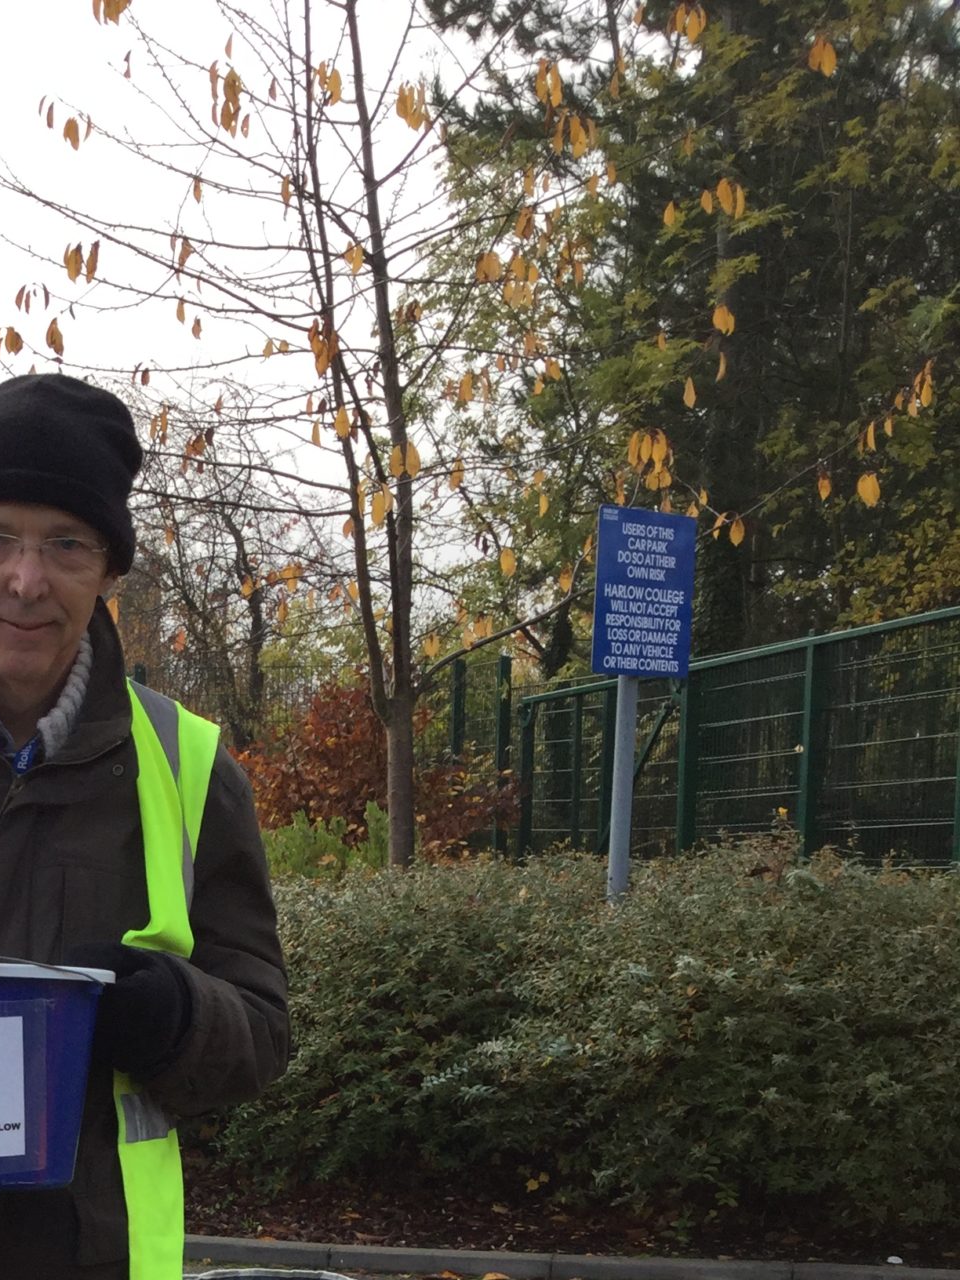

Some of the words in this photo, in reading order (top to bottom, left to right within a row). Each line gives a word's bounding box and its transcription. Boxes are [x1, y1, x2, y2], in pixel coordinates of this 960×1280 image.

[622, 522, 646, 537] USERS
[646, 525, 658, 538] OF
[658, 526, 675, 541] THIS
[628, 537, 646, 552] CAR
[646, 539, 668, 554] PARK
[617, 550, 631, 563] DO
[632, 552, 644, 565] SO
[644, 554, 655, 567] AT
[656, 554, 676, 569] THEIR
[627, 566, 649, 580] OWN
[649, 568, 666, 582] RISK
[604, 583, 644, 600] HARLOW
[645, 588, 684, 605] COLLEGE
[610, 599, 628, 613] WILL
[629, 600, 646, 615] NOT
[647, 603, 678, 618] ACCEPT
[606, 613, 665, 630] RESPONSIBILITY
[665, 618, 681, 632] FOR
[608, 627, 628, 641] LOSS
[628, 629, 641, 642] OR
[642, 630, 678, 645] DAMAGE
[611, 642, 622, 655] TO
[623, 643, 641, 656] ANY
[642, 644, 674, 659] VEHICLE
[603, 656, 616, 668] OR
[617, 656, 638, 670] THEIR
[638, 658, 679, 673] CONTENTS
